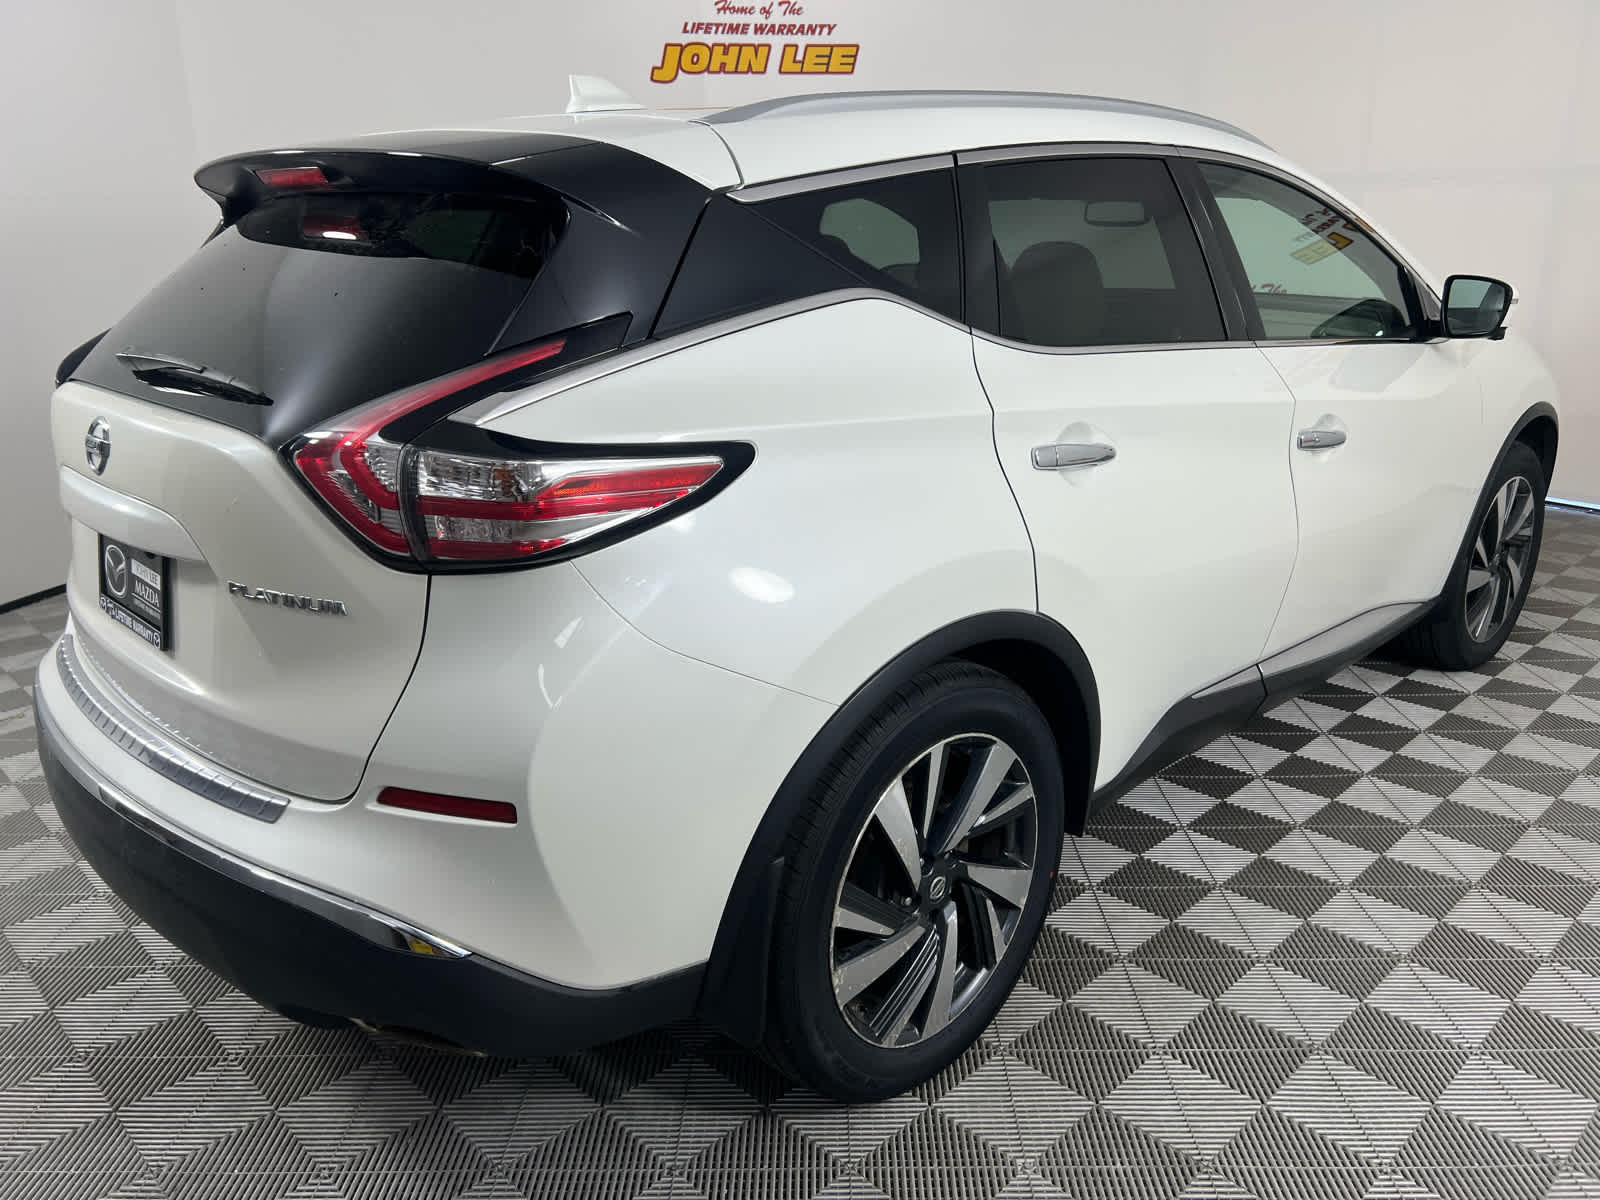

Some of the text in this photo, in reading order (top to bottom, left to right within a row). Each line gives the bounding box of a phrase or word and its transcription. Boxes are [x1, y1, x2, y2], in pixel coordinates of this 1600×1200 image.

[714, 0, 804, 19] Home of The
[682, 21, 837, 36] LIFETIME WARRANTY
[651, 42, 859, 83] JOHN LEE
[135, 580, 160, 608] MAZDA
[227, 580, 347, 615] PLATINUM
